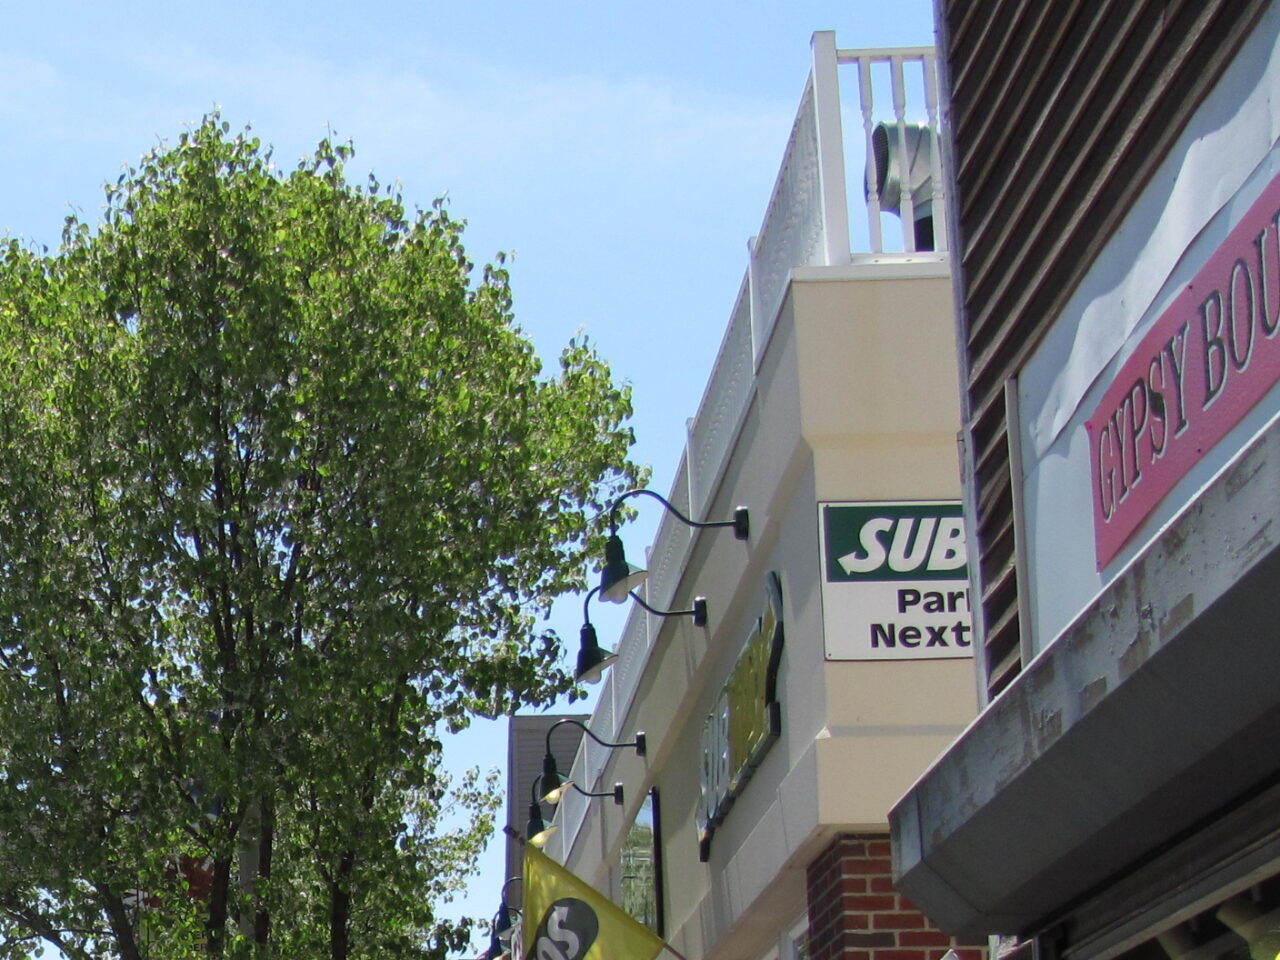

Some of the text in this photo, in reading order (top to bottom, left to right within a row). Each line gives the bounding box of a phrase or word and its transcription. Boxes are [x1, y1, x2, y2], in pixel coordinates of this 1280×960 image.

[1099, 320, 1190, 523] GYPSY
[837, 517, 968, 576] SUB
[897, 587, 971, 613] Par
[870, 620, 971, 648] Next
